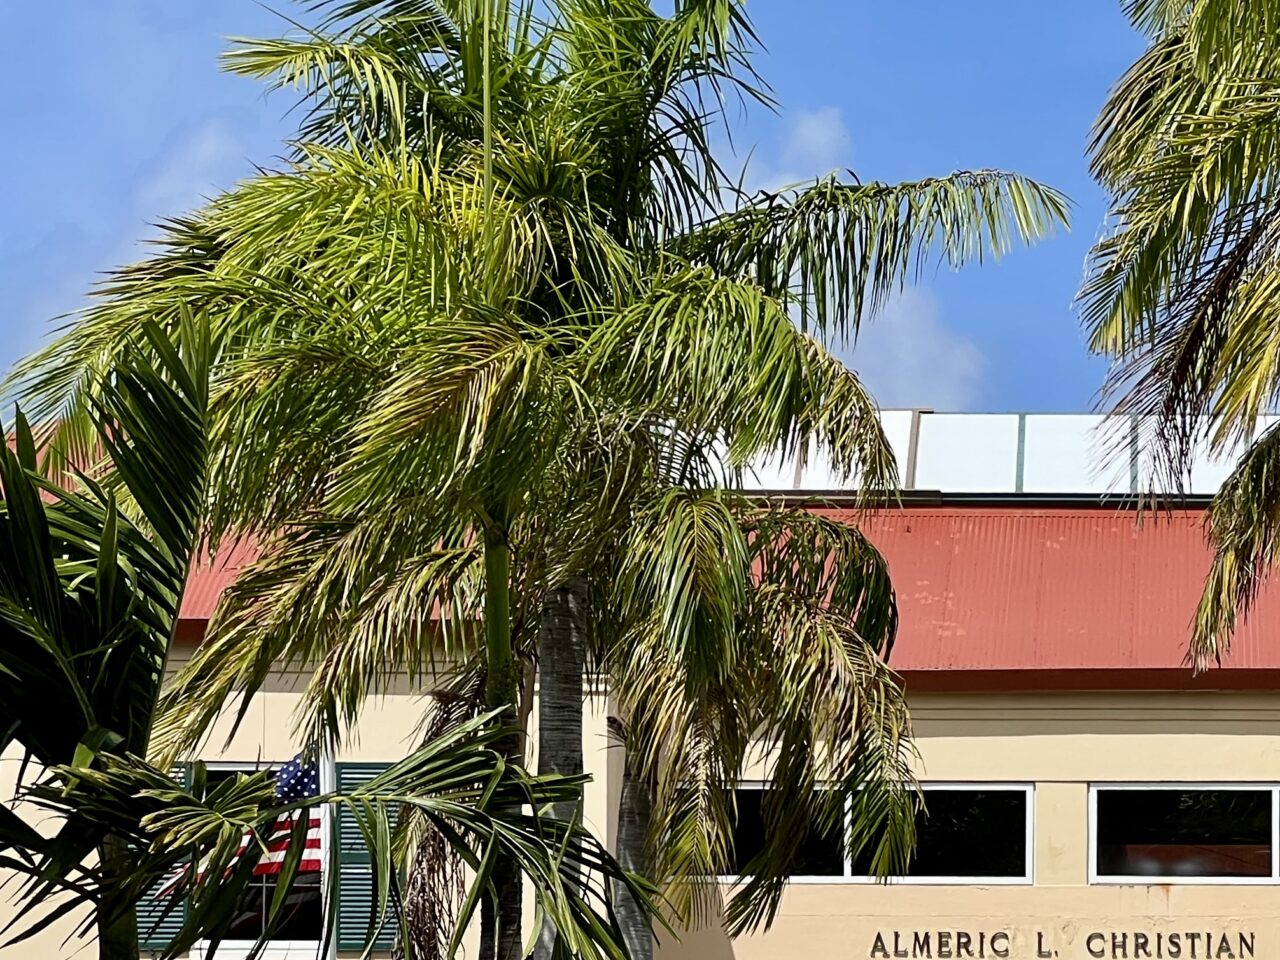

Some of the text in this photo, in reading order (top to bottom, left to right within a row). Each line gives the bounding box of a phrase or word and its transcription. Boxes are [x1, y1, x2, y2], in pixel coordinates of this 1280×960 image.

[870, 931, 1256, 958] ALMERIC L. CHRISTIAN
